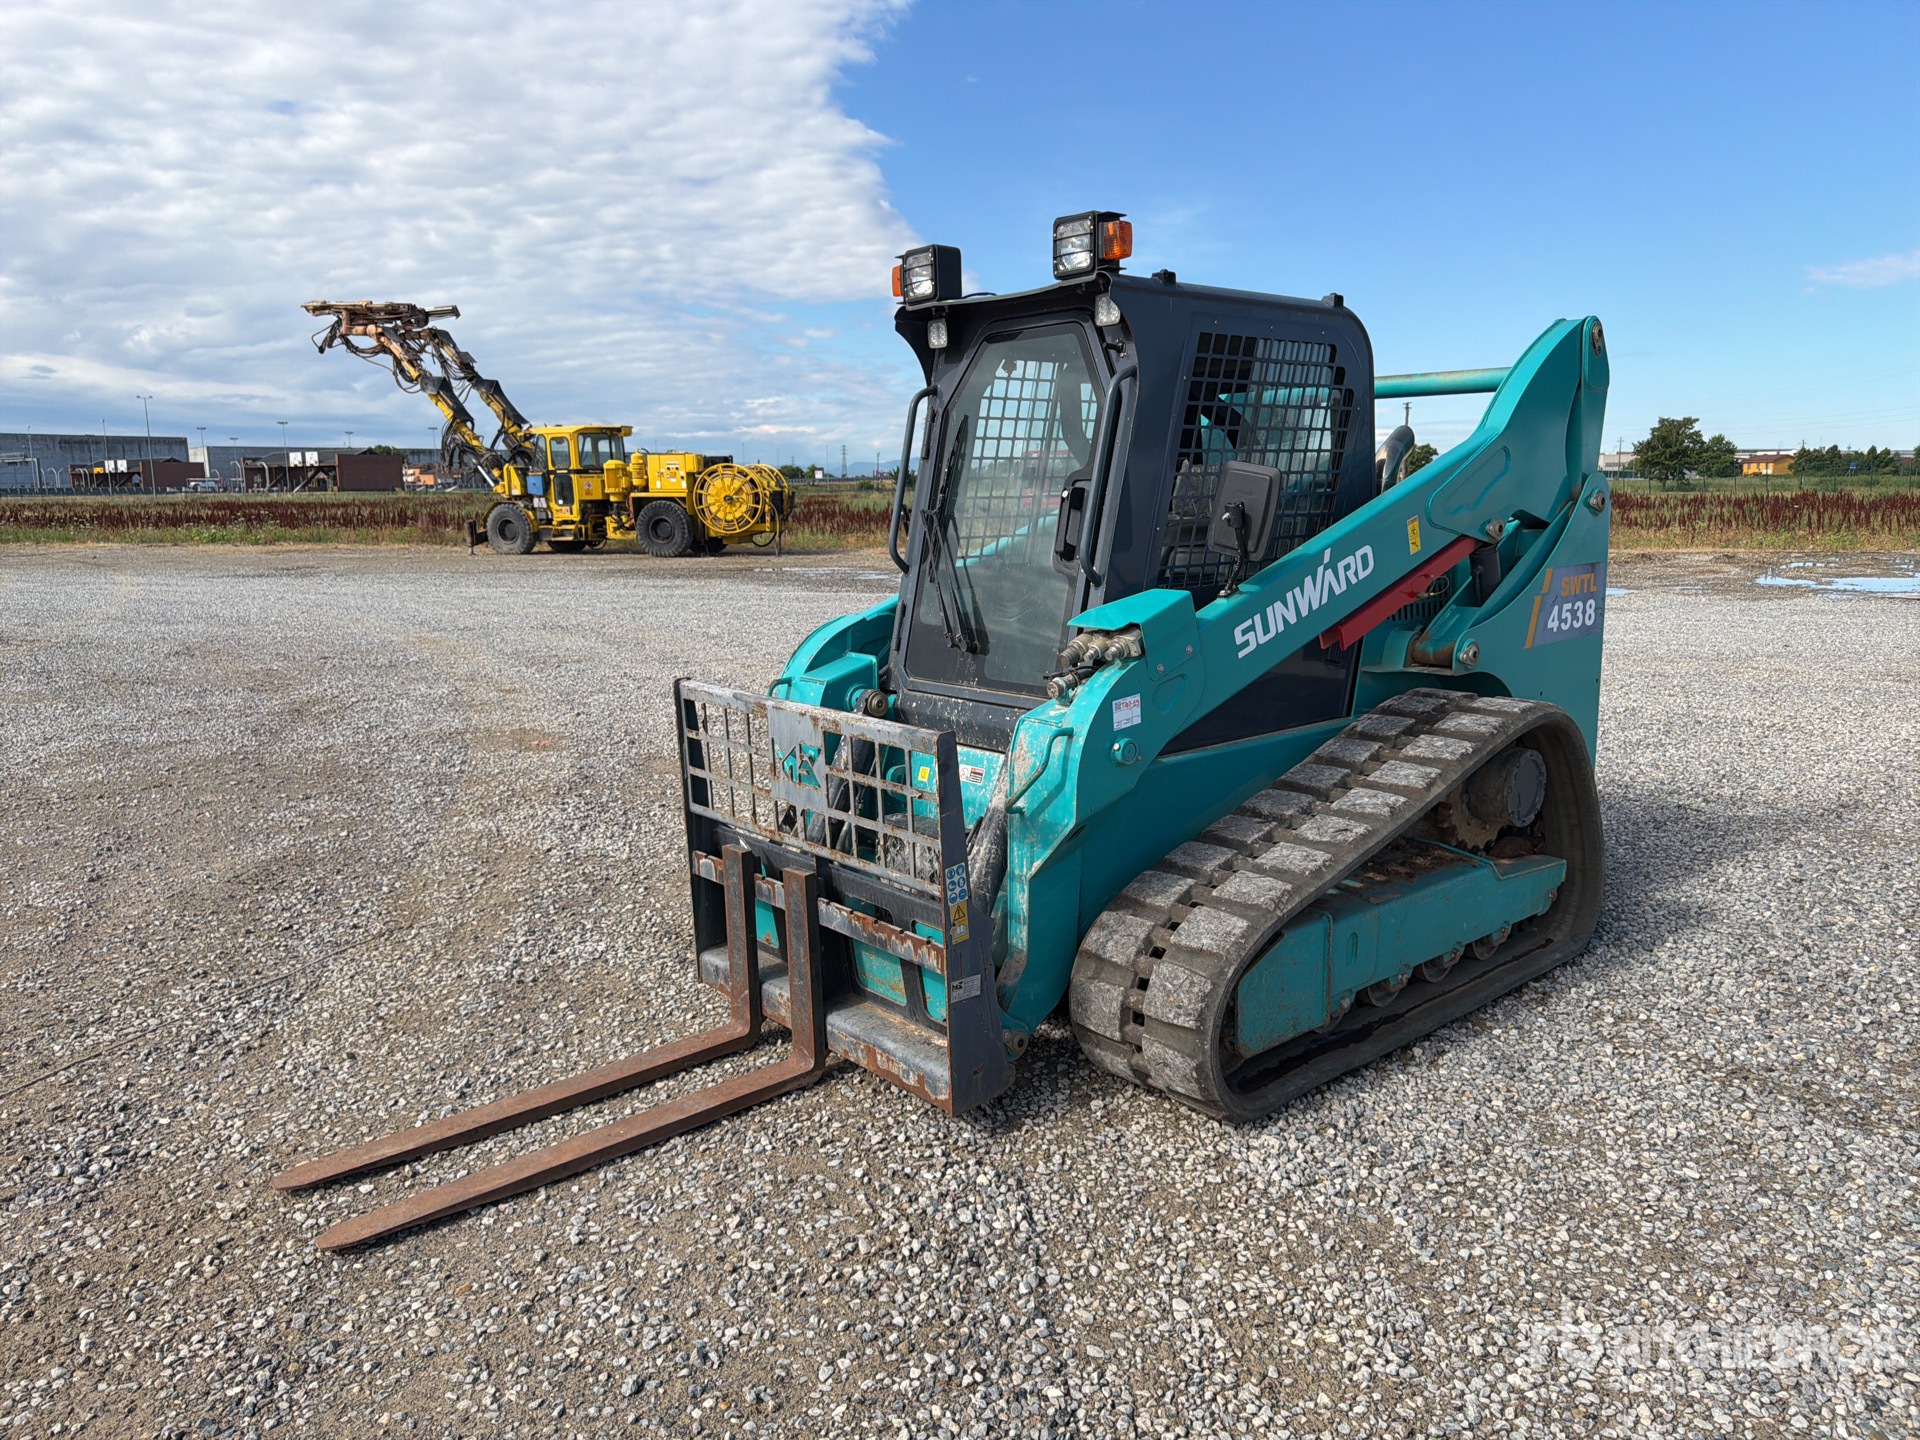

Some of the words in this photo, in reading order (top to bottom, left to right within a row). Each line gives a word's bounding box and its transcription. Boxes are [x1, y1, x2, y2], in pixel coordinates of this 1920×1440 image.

[1234, 544, 1375, 659] SUNWARD
[1561, 573, 1598, 597] SWTL
[1547, 598, 1596, 633] 4538
